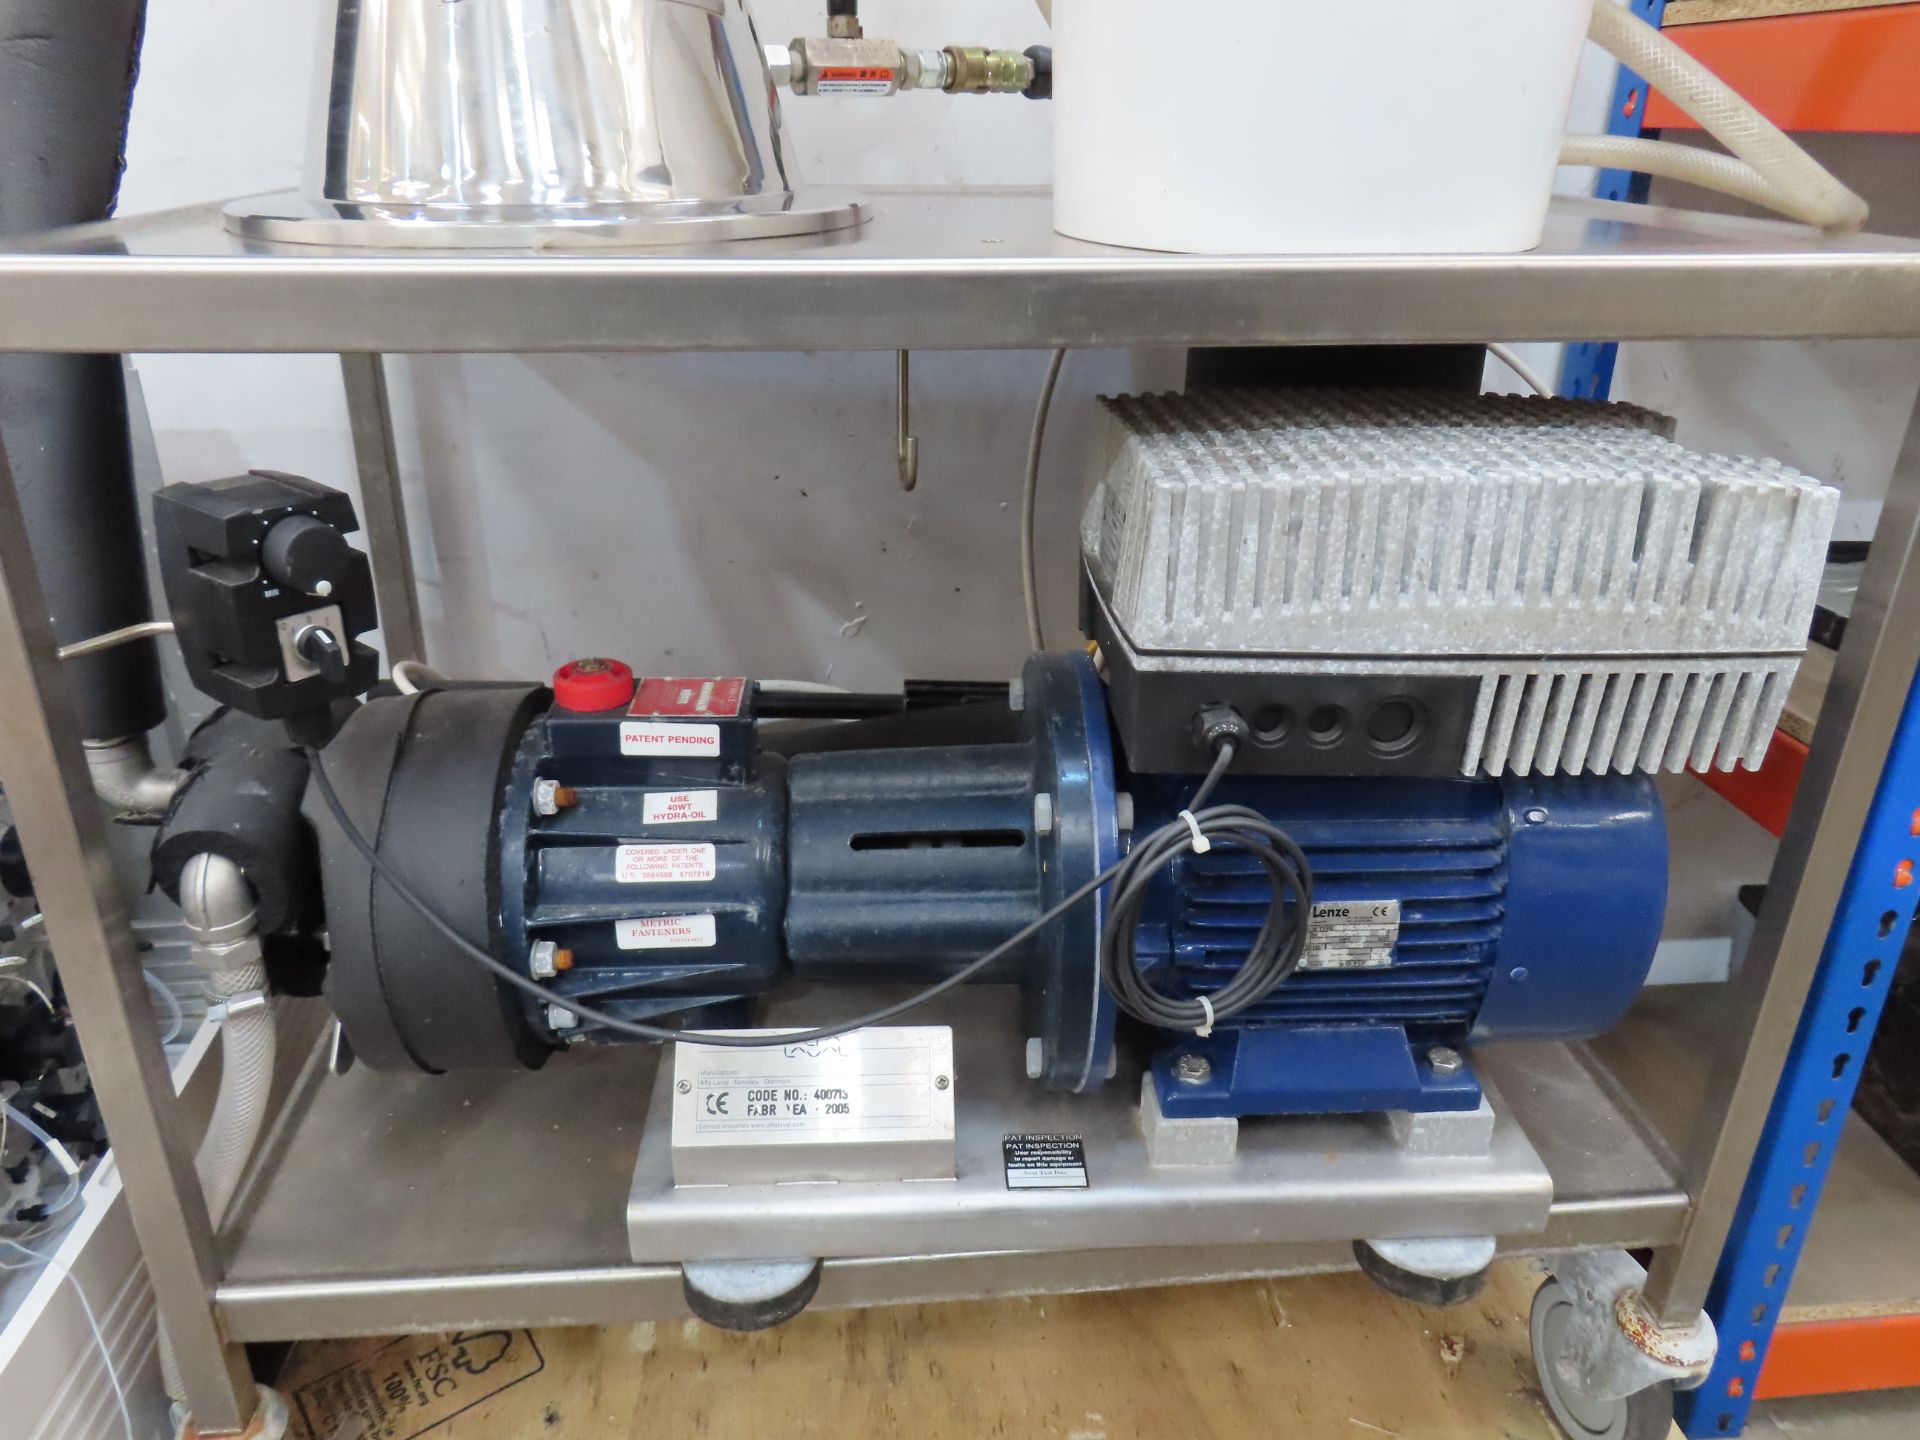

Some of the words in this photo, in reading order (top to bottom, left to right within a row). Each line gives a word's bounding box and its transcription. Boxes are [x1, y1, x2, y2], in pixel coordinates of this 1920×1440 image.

[625, 734, 665, 743] PATENT
[667, 735, 715, 745] PENDING
[670, 795, 689, 803] USE
[666, 803, 692, 811] 40WT
[653, 811, 706, 821] HYDRA-OIL
[625, 848, 660, 856] COVERED
[626, 862, 668, 870] FOLLOWING
[1312, 906, 1350, 918] Lenze
[640, 918, 682, 927] METRIC
[632, 927, 692, 937] FASTENERS
[784, 1046, 849, 1058] LAVAL
[747, 1089, 778, 1102] CODE
[784, 1089, 808, 1101] NO.:
[825, 1103, 850, 1114] 2005
[416, 1345, 458, 1399] FSC
[403, 1358, 430, 1407] www.fsc.org
[383, 1371, 413, 1414] 100%
